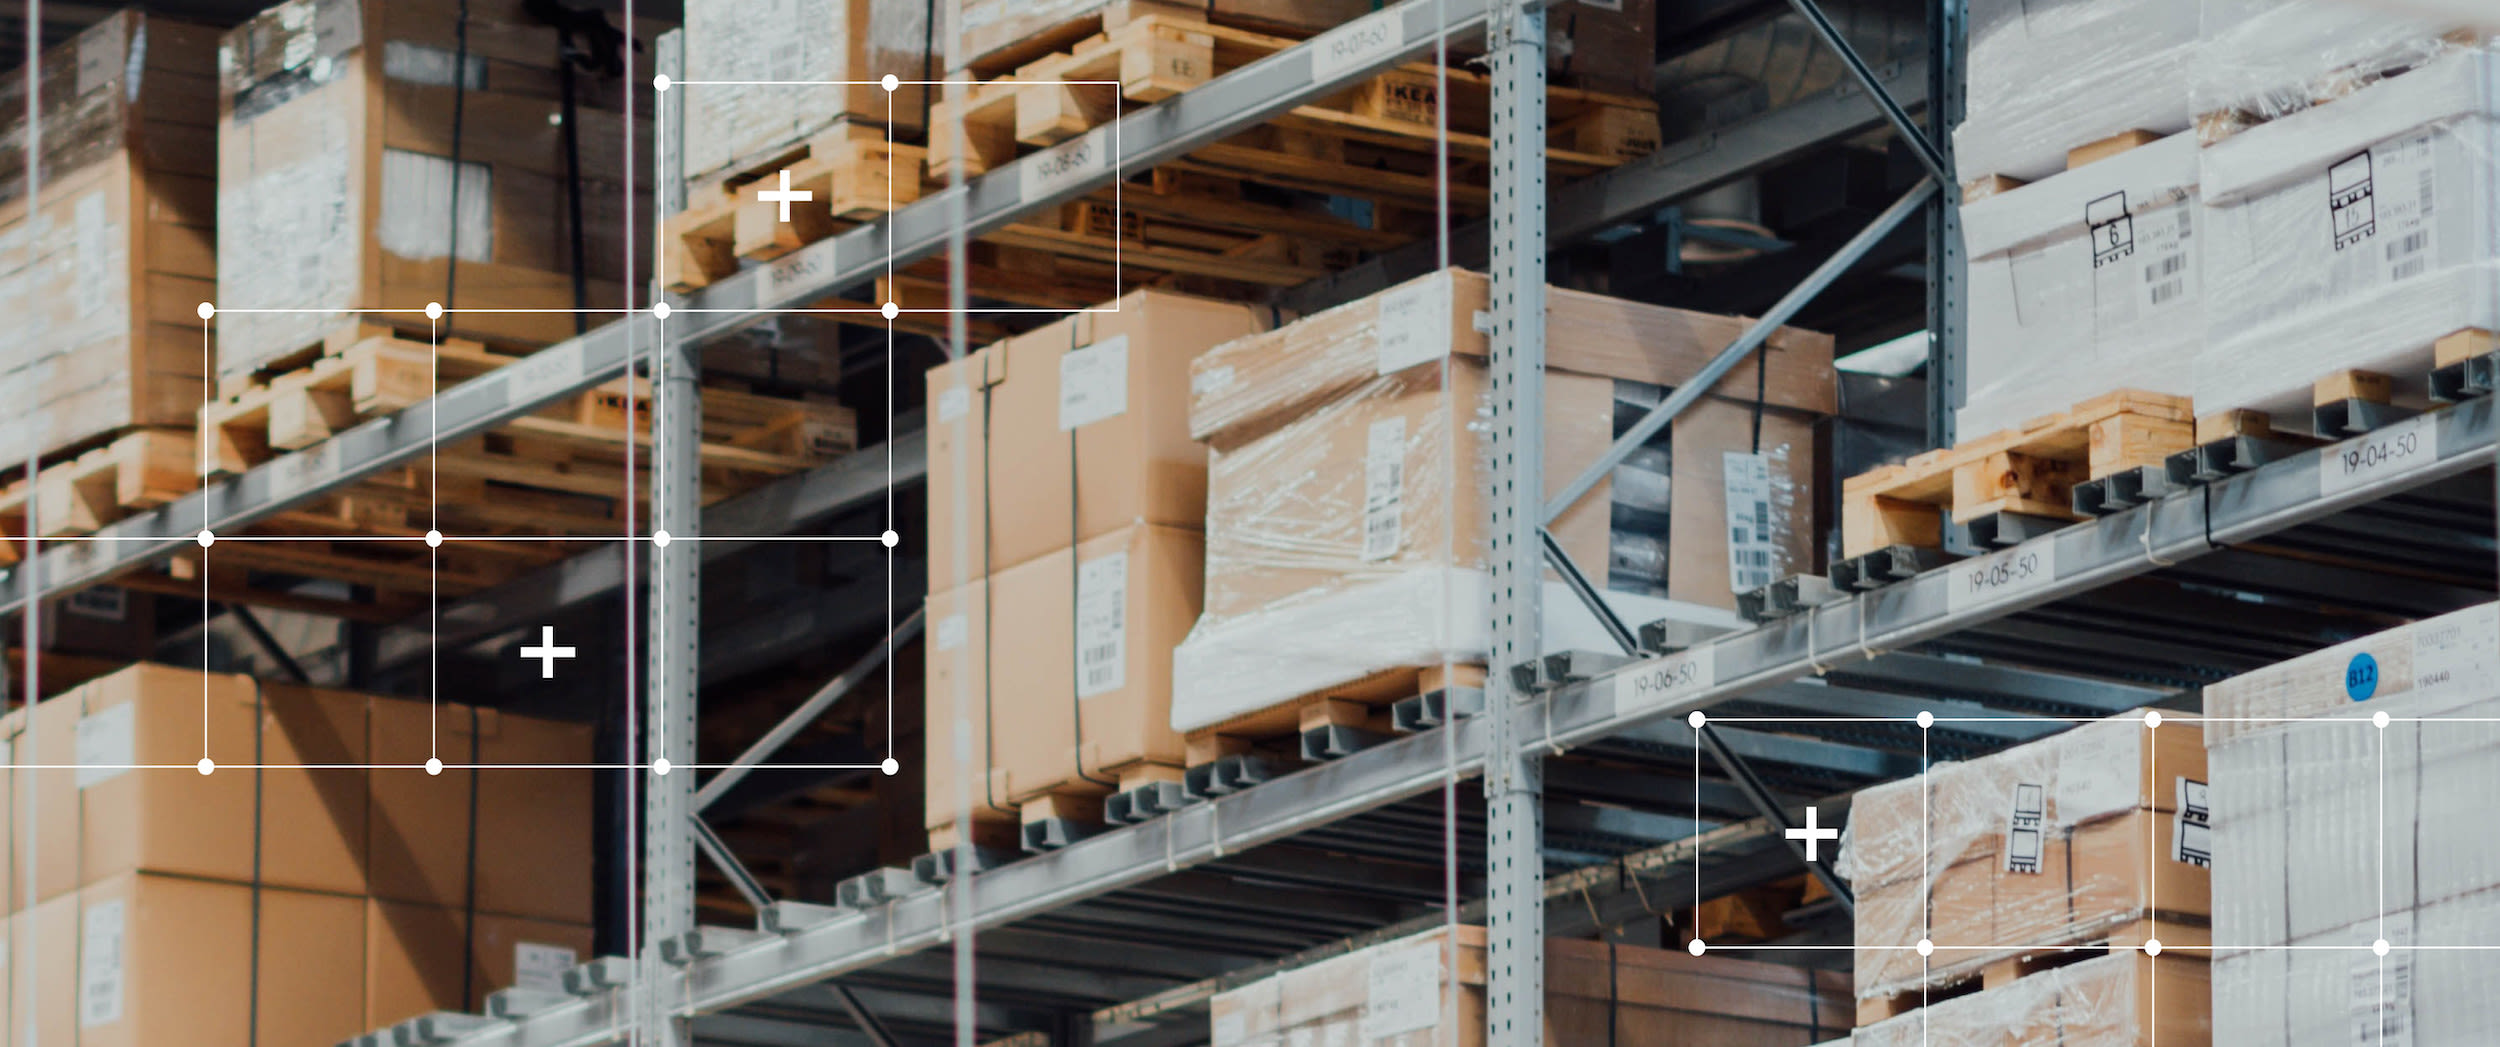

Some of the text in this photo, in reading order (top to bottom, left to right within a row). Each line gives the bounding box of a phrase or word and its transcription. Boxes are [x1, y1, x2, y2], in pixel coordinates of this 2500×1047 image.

[1385, 84, 1437, 104] IKEA
[2109, 223, 2119, 246] 6
[2343, 432, 2417, 474] 19-04-50
[1968, 552, 2038, 592] 19-05-50
[1634, 661, 1697, 697] 19-06-50
[2349, 664, 2374, 689] B12
